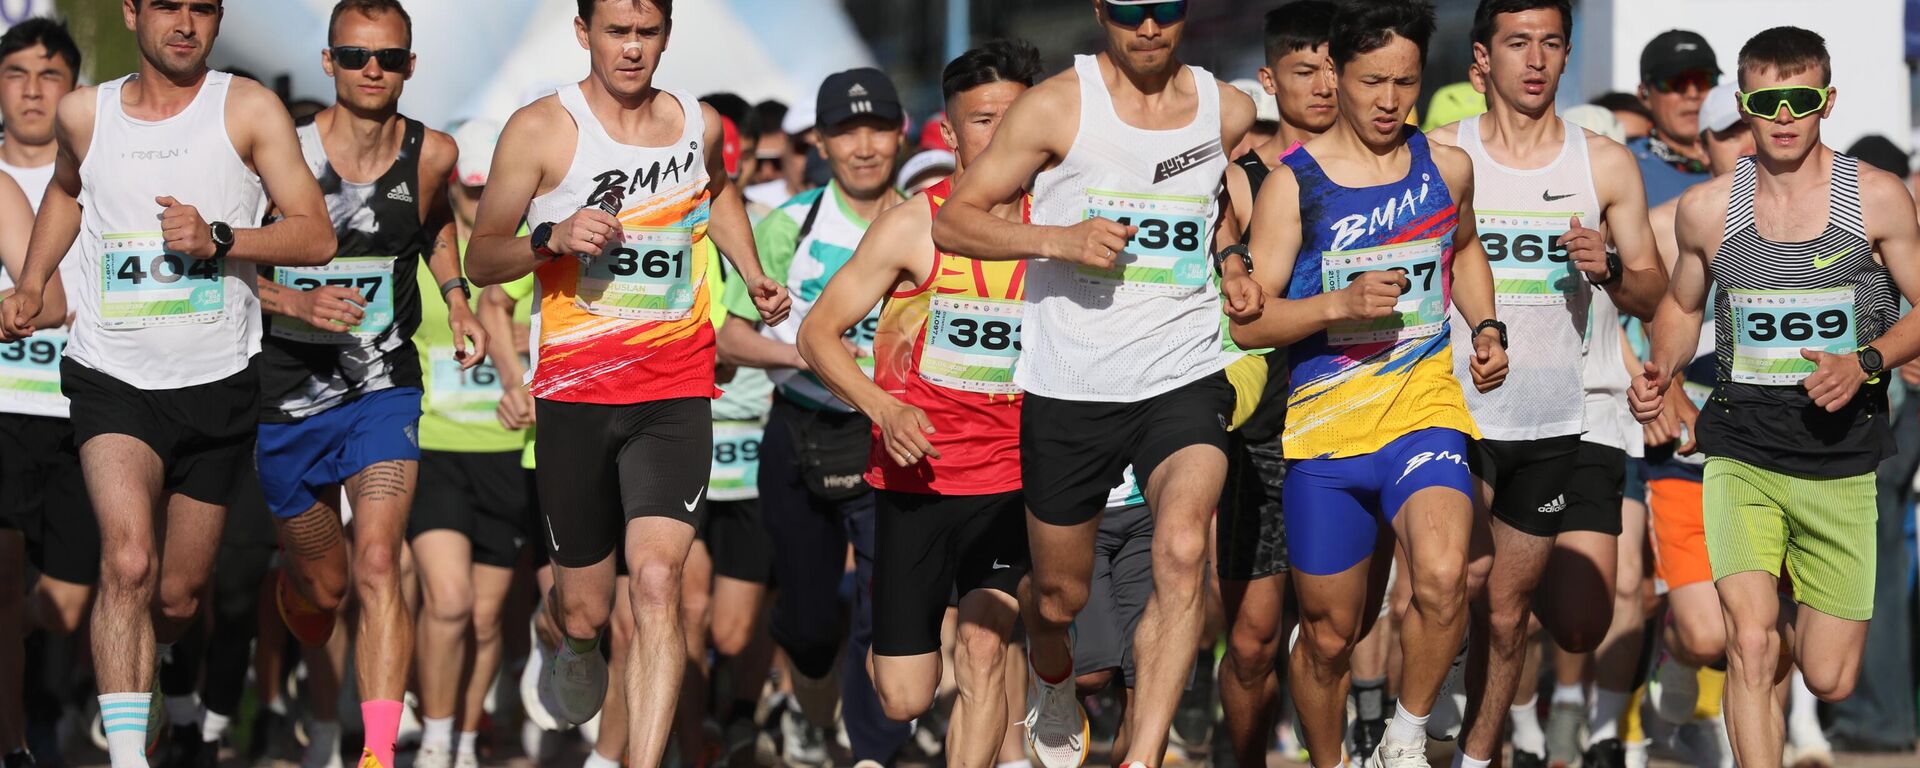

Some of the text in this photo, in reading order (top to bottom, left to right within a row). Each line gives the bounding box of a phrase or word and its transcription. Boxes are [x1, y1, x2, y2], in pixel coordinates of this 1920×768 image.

[387, 192, 413, 203] adidas
[608, 247, 684, 278] 361
[1480, 233, 1569, 263] 365
[117, 255, 219, 285] 404
[1747, 310, 1848, 342] 369
[1, 338, 68, 364] 39
[1537, 504, 1567, 513] adidas
